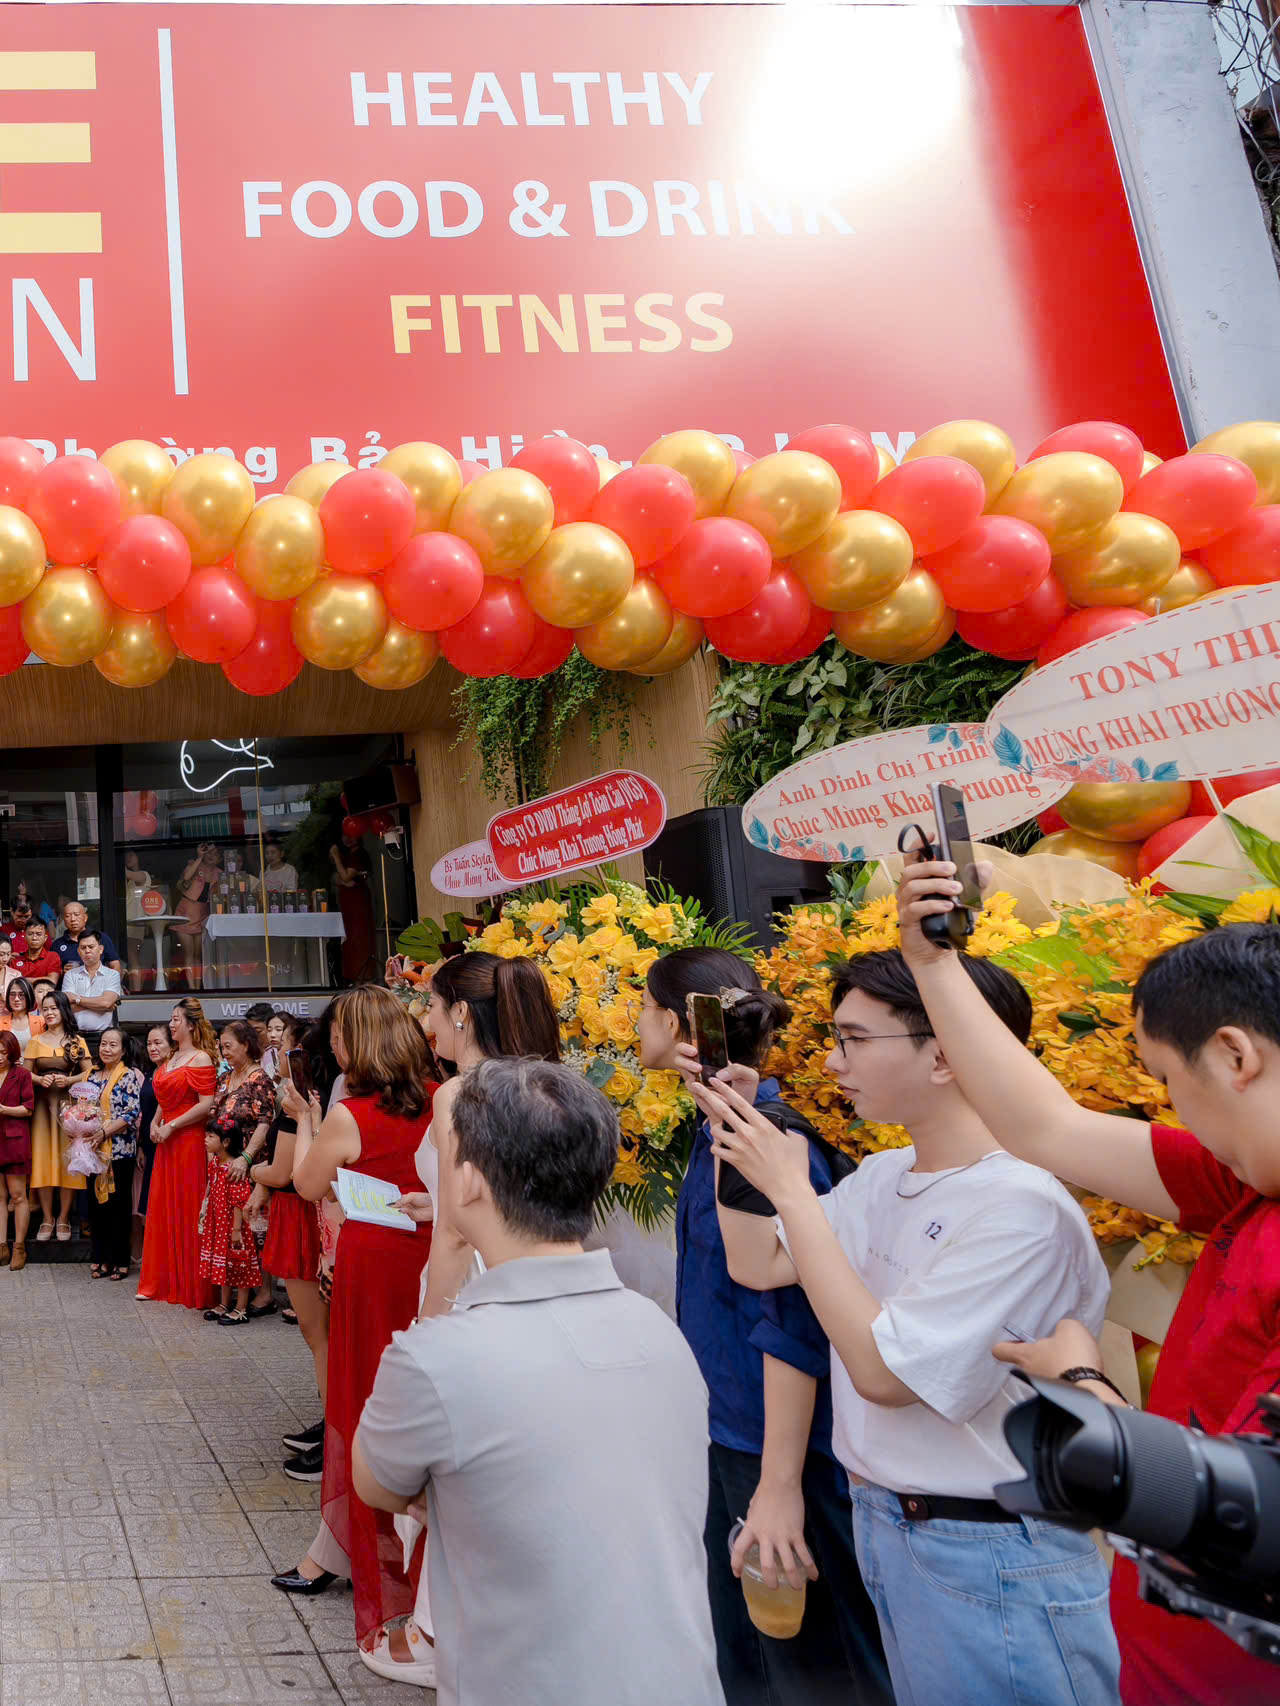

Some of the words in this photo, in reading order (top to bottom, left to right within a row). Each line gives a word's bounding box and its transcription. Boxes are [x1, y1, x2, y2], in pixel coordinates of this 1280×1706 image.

[350, 71, 714, 127] HEALTHY
[242, 180, 485, 239] FOOD
[508, 179, 570, 238] &
[589, 179, 856, 237] DRINK
[390, 292, 735, 354] FITNESS
[1070, 647, 1185, 701] TONY
[1193, 619, 1280, 670] THỊ
[1097, 709, 1172, 751] KHAI
[777, 784, 817, 807] Anh
[876, 759, 917, 779] Chị
[495, 825, 521, 848] Công
[523, 814, 538, 838] CP
[518, 851, 539, 874] Chúc
[558, 835, 581, 862] Khai
[624, 816, 645, 842] Phát
[772, 814, 825, 842] Chúc
[220, 1001, 310, 1017] WEOME
[925, 1222, 942, 1240] 12
